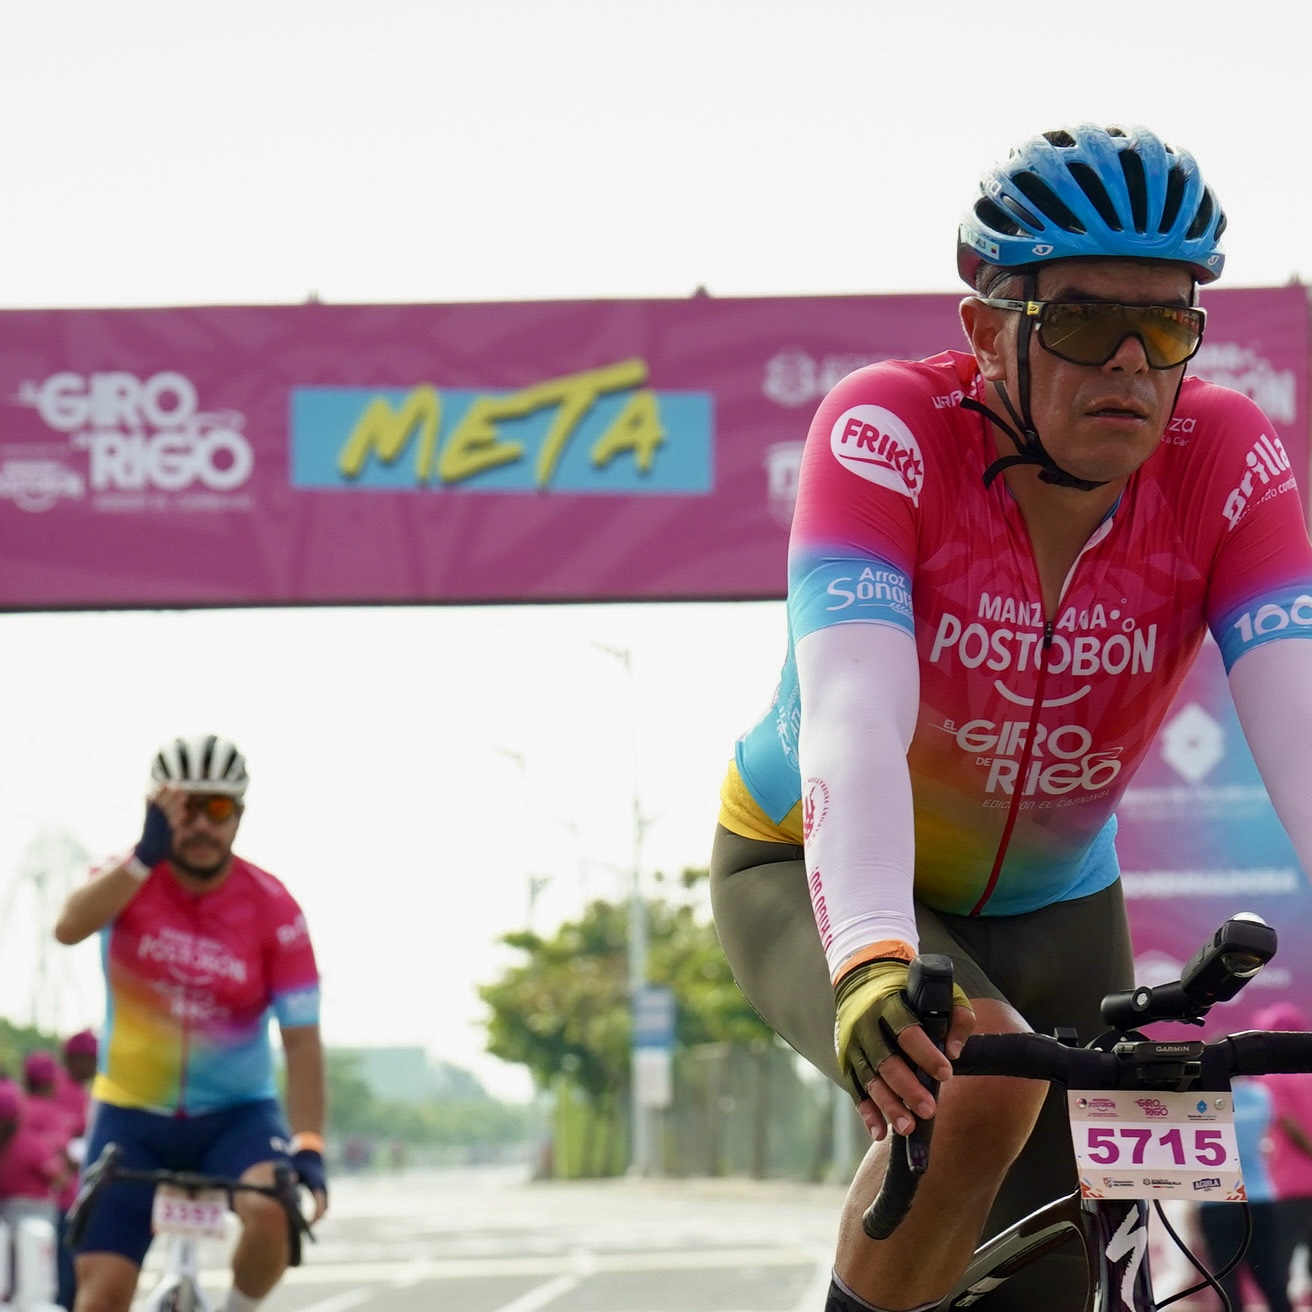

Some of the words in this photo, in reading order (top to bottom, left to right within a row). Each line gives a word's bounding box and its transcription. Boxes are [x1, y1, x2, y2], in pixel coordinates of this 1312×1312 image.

[37, 371, 198, 431] GIRO
[338, 358, 666, 491] META
[90, 431, 254, 492] RIGO
[1222, 433, 1291, 532] Brilla
[826, 577, 912, 611] Sonor
[858, 567, 905, 588] Arroz
[943, 719, 957, 732] EL
[956, 719, 1092, 760] GIRO
[976, 756, 992, 767] DE
[985, 757, 1121, 796] RIGO
[1087, 1128, 1227, 1167] 5715
